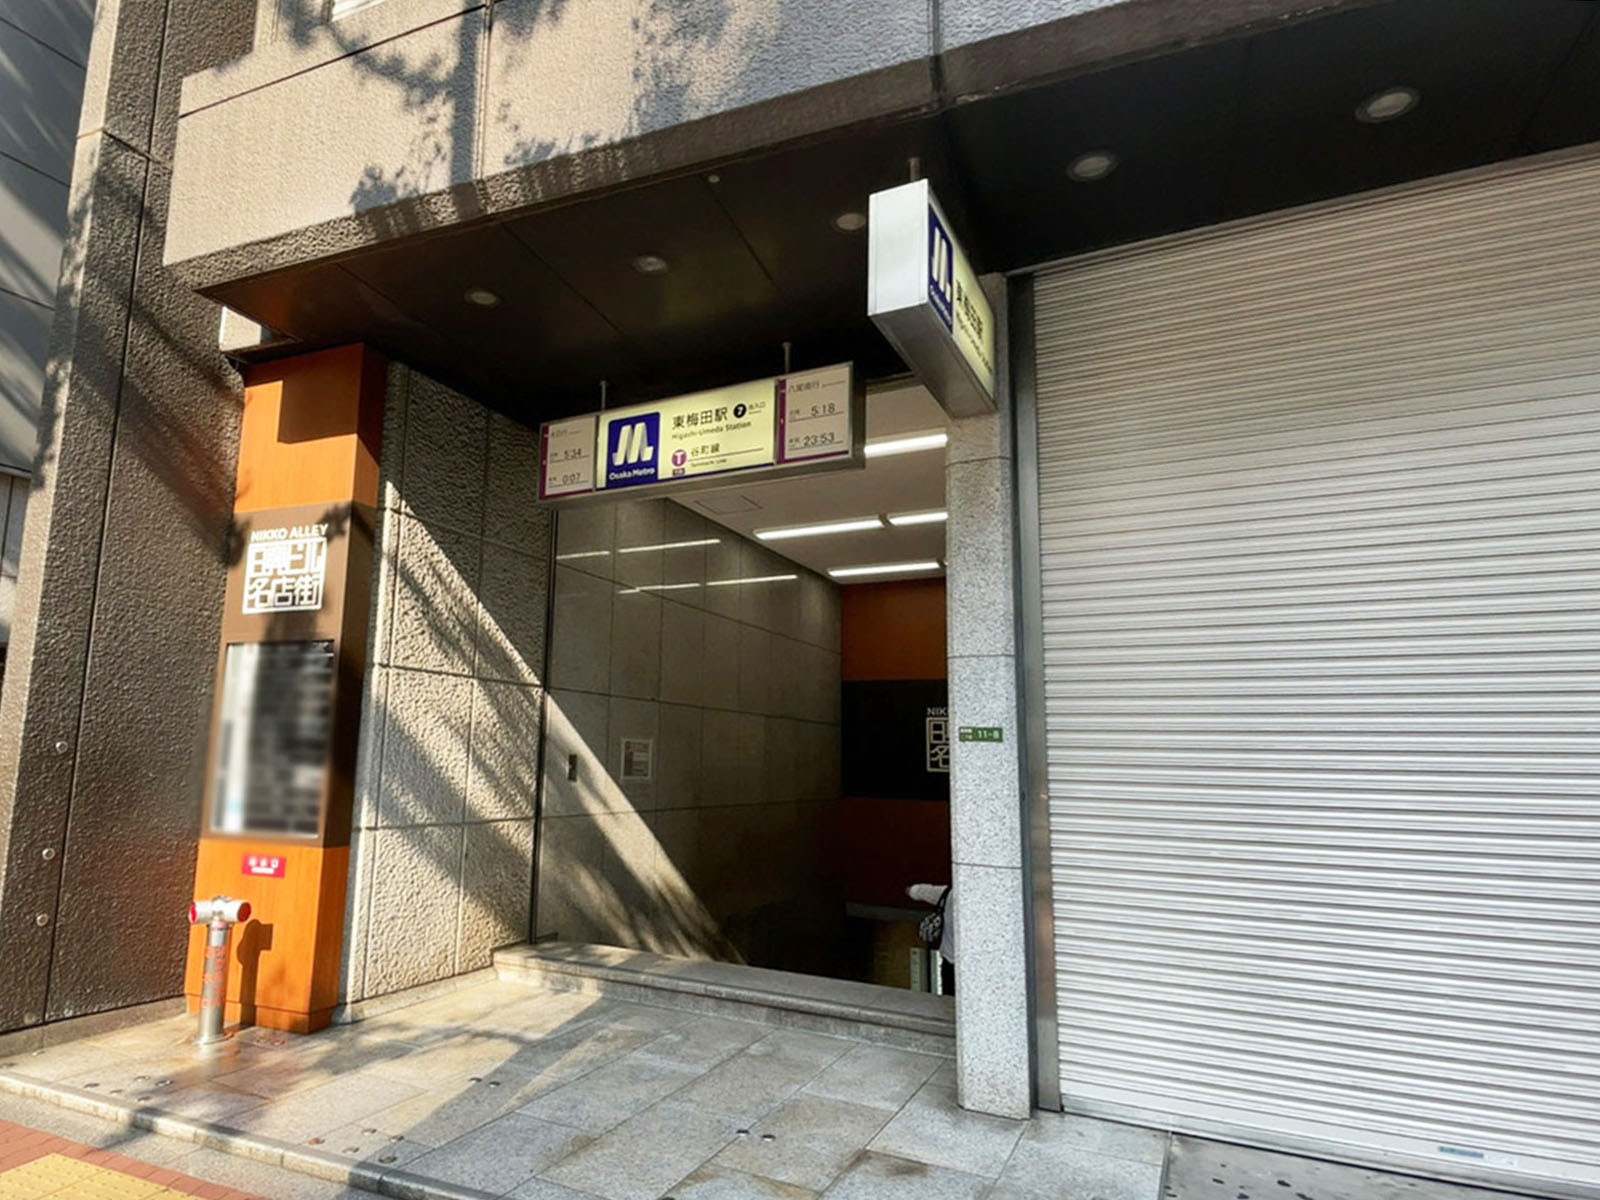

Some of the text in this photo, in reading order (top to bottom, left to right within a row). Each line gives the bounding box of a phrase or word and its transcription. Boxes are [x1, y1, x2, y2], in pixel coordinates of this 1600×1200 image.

[672, 407, 728, 430] 東梅田駅
[725, 421, 751, 431] Station
[803, 431, 835, 448] 23:53
[690, 443, 721, 457] 谷町線
[609, 467, 656, 480] Osaka Metro
[250, 523, 329, 542] NIKKO ALLEY
[246, 574, 321, 609] 名店街
[926, 706, 949, 717] NIK
[930, 721, 949, 744] 日
